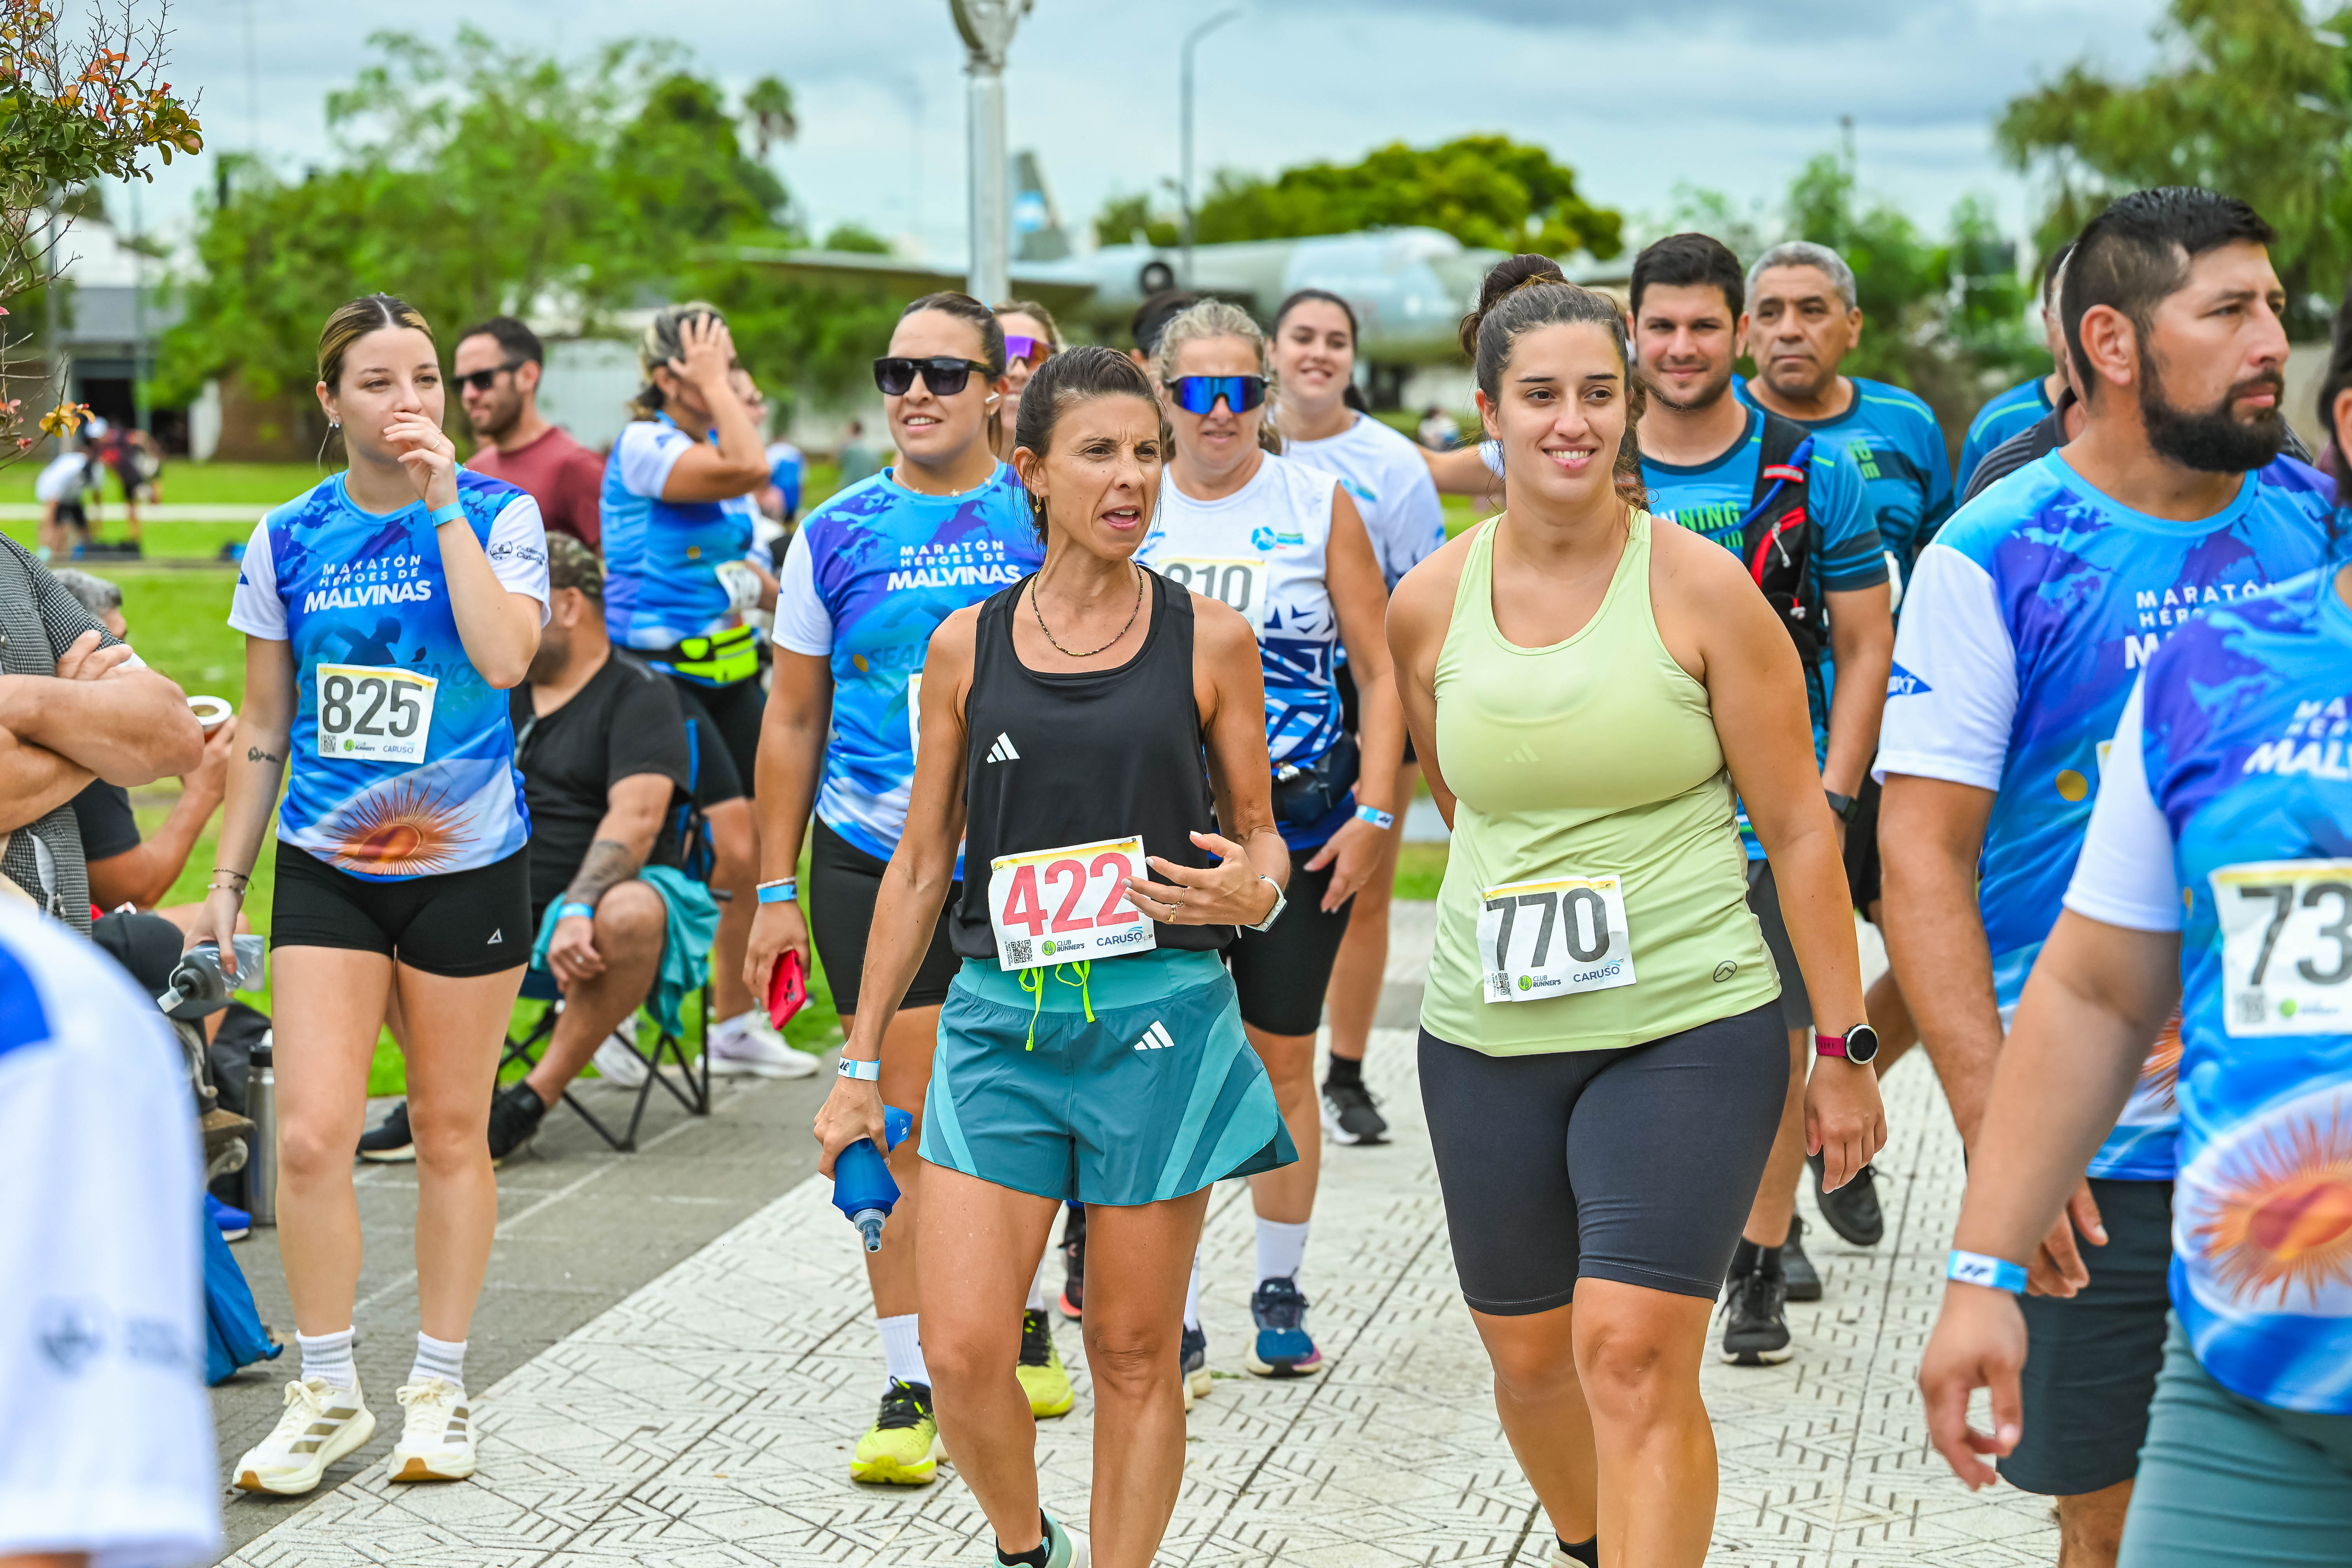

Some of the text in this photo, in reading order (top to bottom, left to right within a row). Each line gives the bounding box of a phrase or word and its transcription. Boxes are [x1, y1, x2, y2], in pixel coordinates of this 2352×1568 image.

[900, 539, 1004, 556] MARATÓN
[983, 552, 1005, 562] DE
[322, 554, 421, 576] MARATÓN
[319, 567, 419, 587] HÉROES DE
[886, 564, 1023, 591] MALVINAS
[303, 579, 432, 614] MALVINAS
[2136, 579, 2276, 609] MARATÓ
[322, 675, 422, 737] 825
[383, 745, 414, 753] CARUSO
[2241, 738, 2352, 779] MAL
[1002, 852, 1139, 936] 422
[1097, 932, 1142, 946] CARUSO
[1486, 887, 1610, 971] 770
[1057, 943, 1085, 952] RUNNER'S
[1533, 979, 1561, 988] RUNNER'S
[1573, 966, 1620, 982] CARUSO
